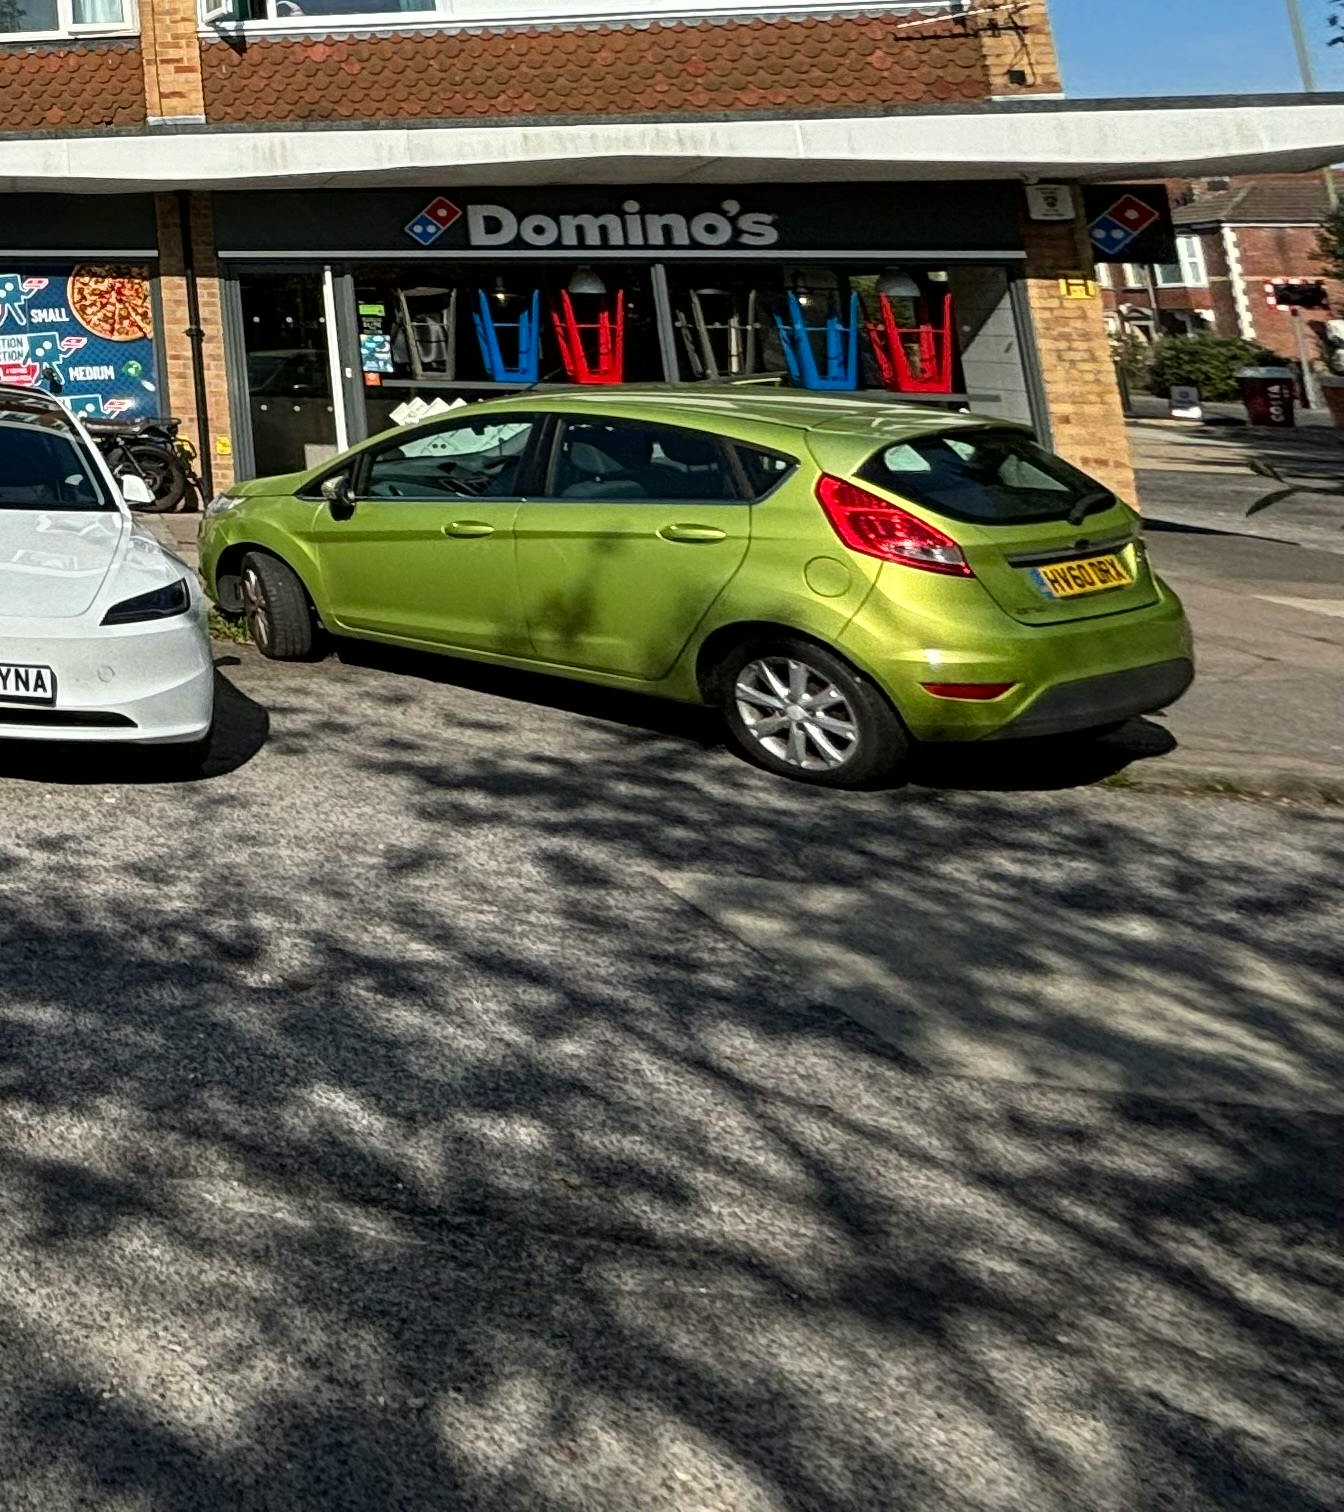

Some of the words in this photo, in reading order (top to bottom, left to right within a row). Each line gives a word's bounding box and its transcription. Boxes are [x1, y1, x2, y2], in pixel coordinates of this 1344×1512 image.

[466, 199, 779, 246] Domino's
[30, 307, 69, 324] SMALL
[69, 365, 115, 381] MEDIUM
[1042, 564, 1097, 594] HV60
